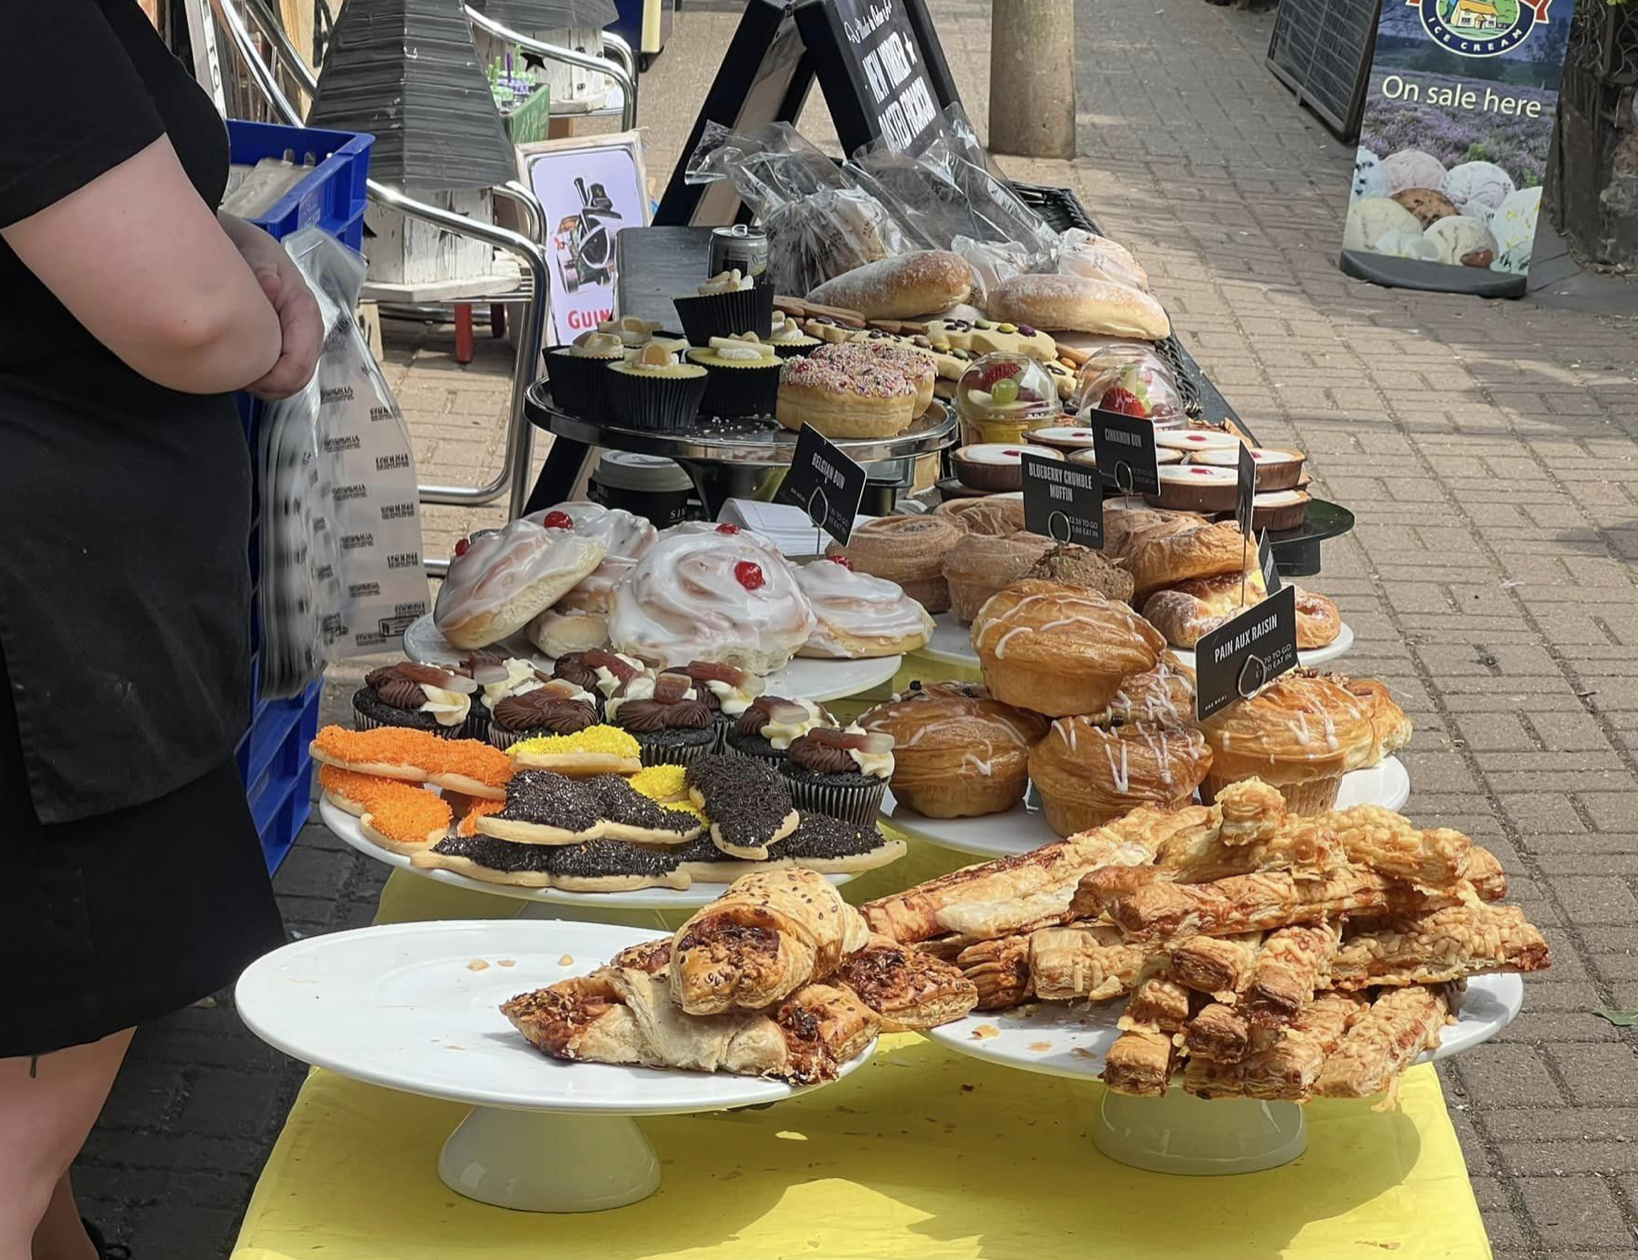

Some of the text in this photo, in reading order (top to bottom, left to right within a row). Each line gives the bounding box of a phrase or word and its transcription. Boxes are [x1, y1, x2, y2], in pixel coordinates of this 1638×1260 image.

[1427, 16, 1523, 52] ICE CREAM
[1382, 75, 1542, 118] On sale here
[811, 452, 846, 490] BELGIAN BUN
[1028, 461, 1093, 490] BLUEBERRY CRUMBLE
[1049, 483, 1073, 502] MUFFIN
[1214, 613, 1278, 664] PAIN AUX RAISIN
[1272, 649, 1281, 659] TO
[1281, 643, 1292, 654] GO
[1272, 656, 1284, 669] EAT
[1284, 652, 1292, 661] IN
